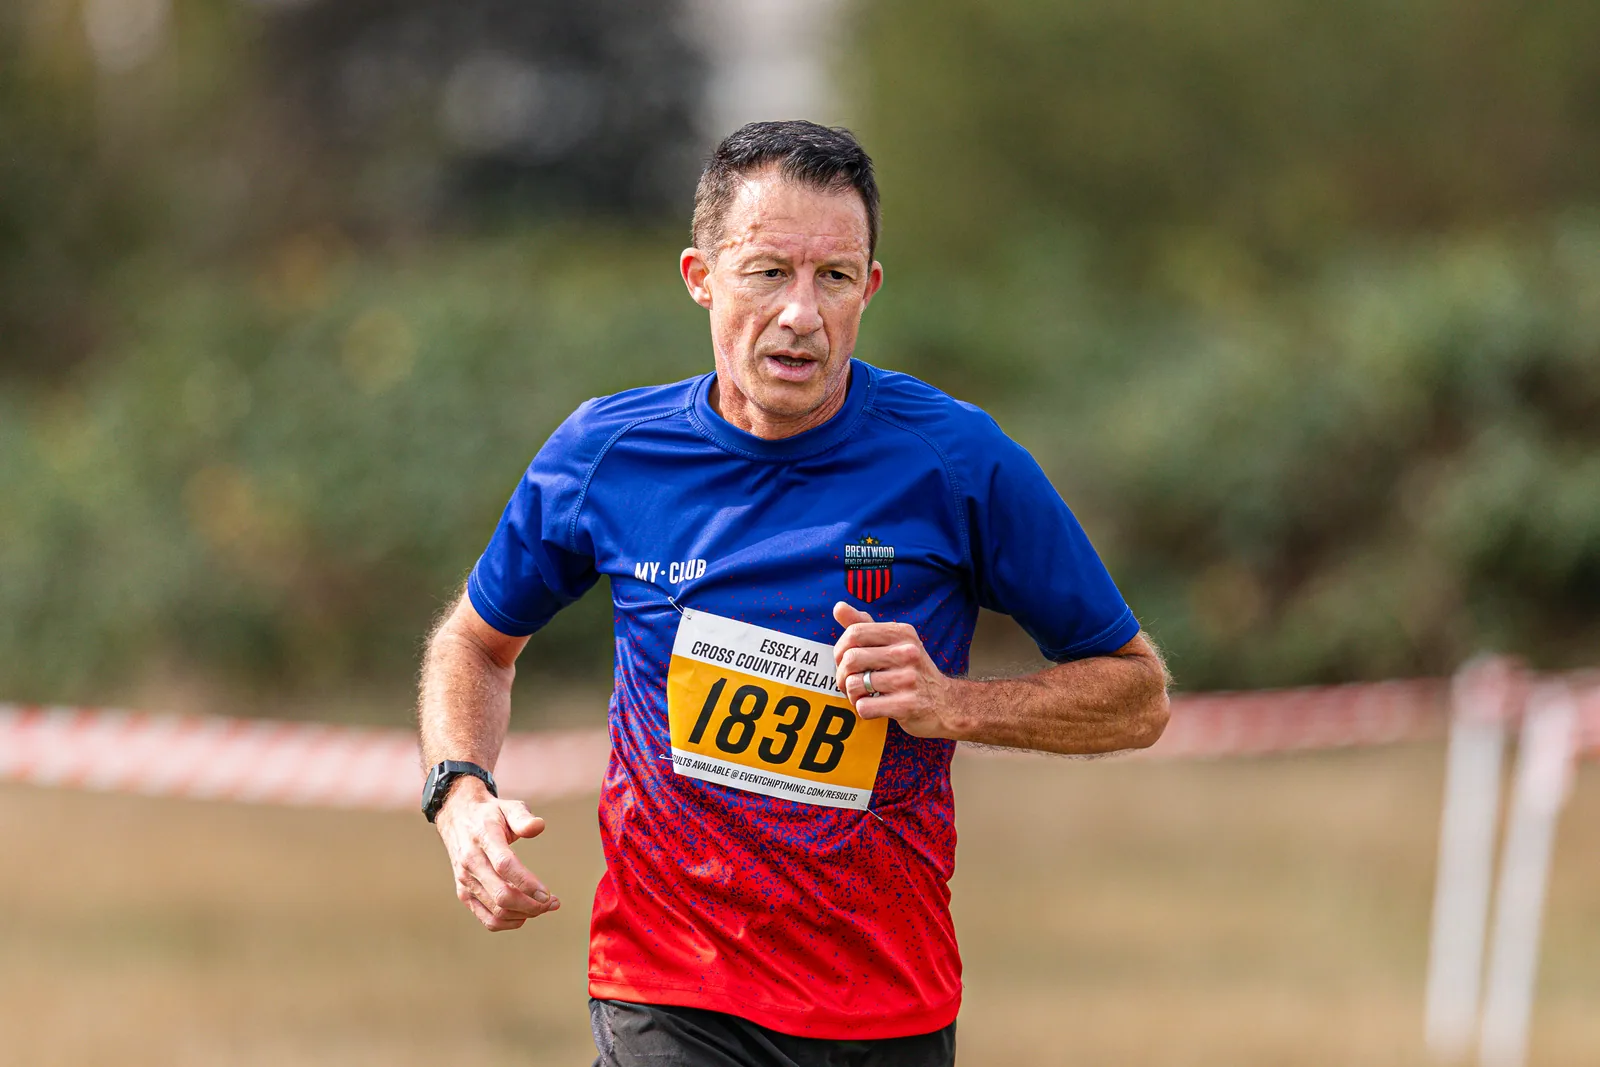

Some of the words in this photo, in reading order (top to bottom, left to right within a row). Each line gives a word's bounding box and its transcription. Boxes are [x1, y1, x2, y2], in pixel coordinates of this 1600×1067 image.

[845, 545, 895, 558] BRENTWOOD
[691, 641, 735, 664] CROSS
[735, 652, 796, 681] COUNTRY
[759, 638, 801, 661] ESSEX
[800, 651, 820, 667] AA
[688, 677, 857, 774] 183B
[691, 760, 732, 777] AVAILABLE
[730, 769, 740, 779] @
[739, 771, 858, 802] EVENTCHIPTIMING.COM/RESULTS
